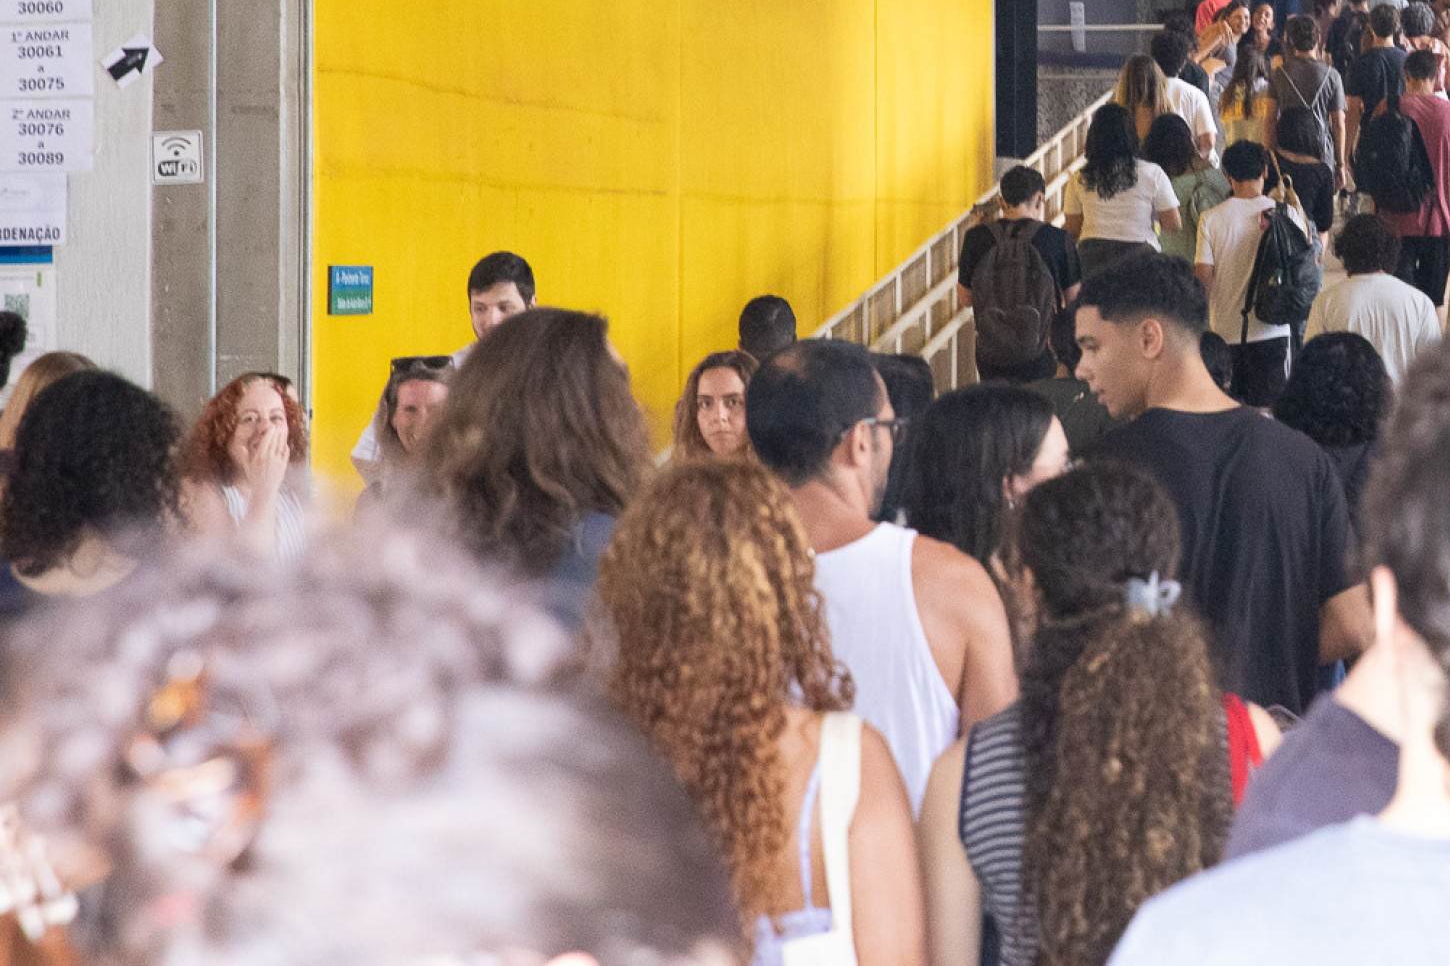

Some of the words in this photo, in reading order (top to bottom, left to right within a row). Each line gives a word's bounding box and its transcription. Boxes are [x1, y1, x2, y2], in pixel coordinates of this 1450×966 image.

[18, 1, 63, 14] 30060
[26, 30, 69, 42] ANDAR
[18, 45, 62, 59] 30061
[18, 77, 64, 91] 30075
[27, 109, 71, 120] ANDAR
[18, 122, 64, 135] 30076
[18, 152, 64, 165] 30089
